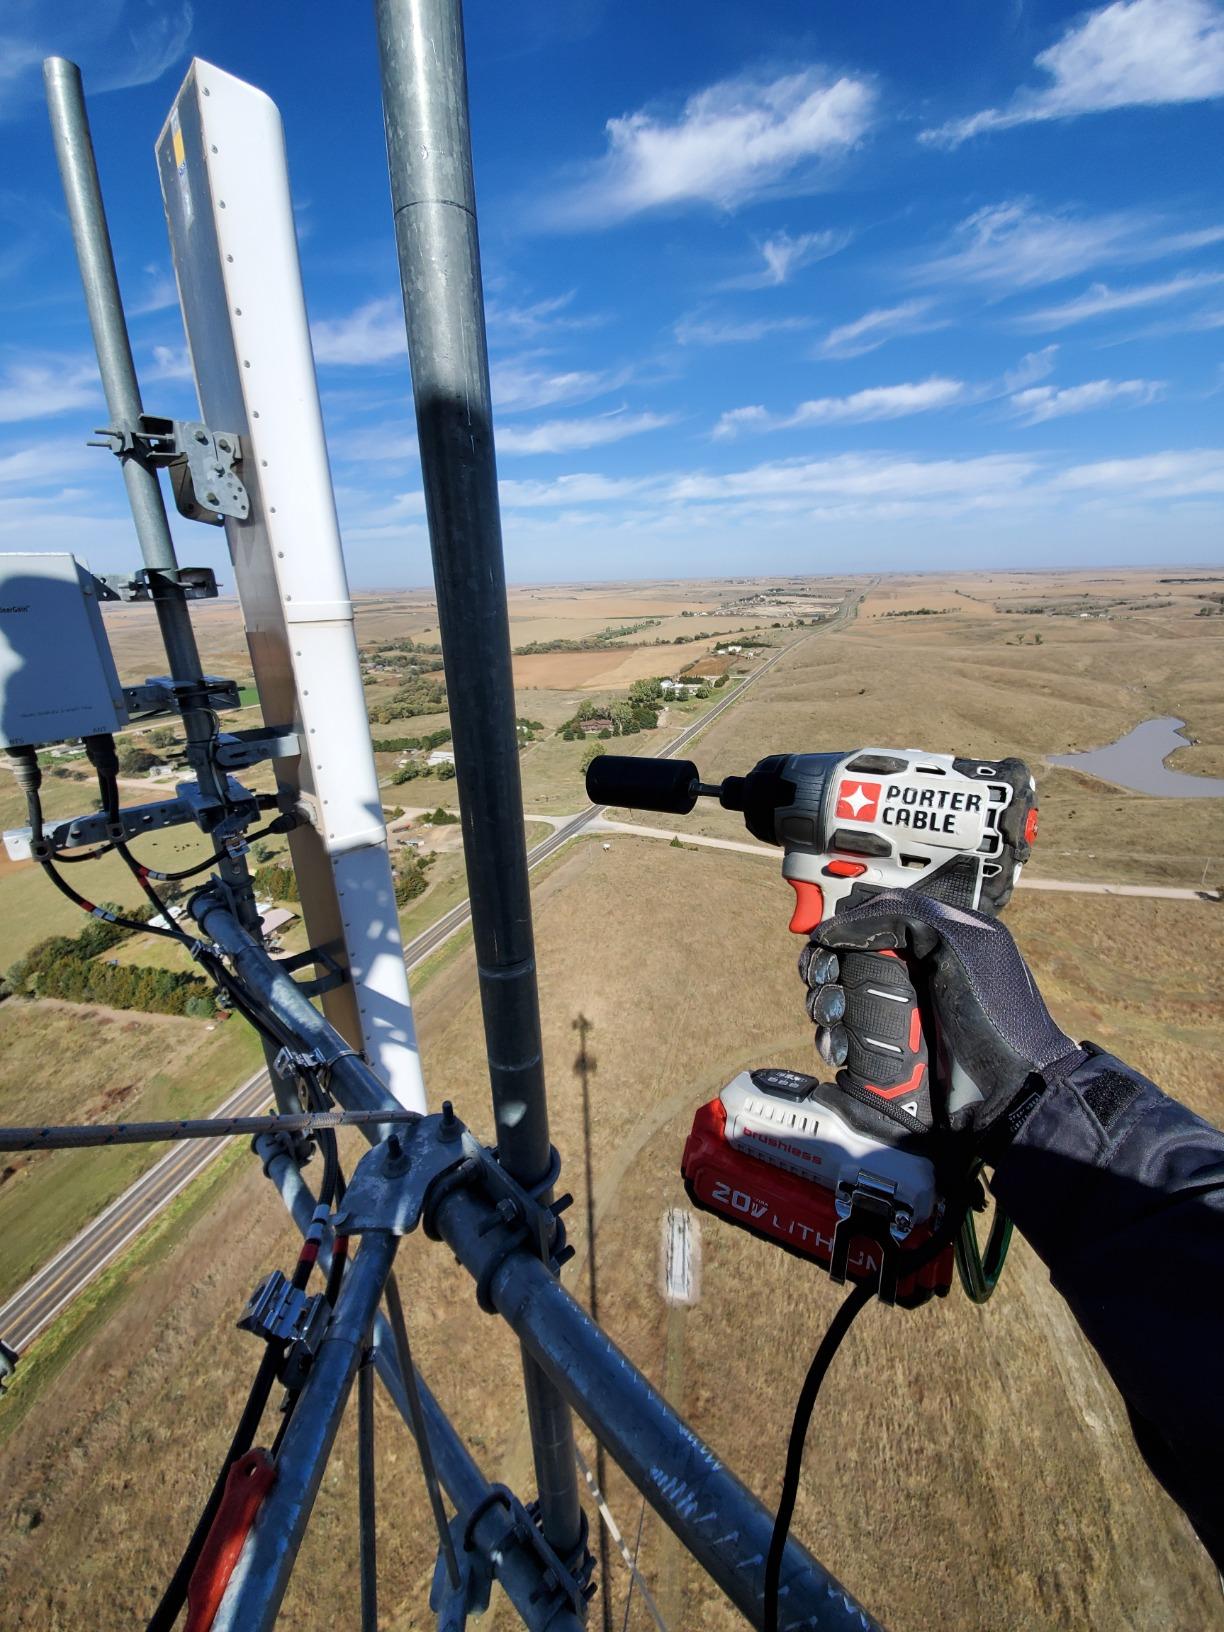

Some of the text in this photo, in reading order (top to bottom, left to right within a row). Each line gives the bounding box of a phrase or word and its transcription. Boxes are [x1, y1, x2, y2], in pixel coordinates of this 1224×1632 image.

[886, 785, 982, 812] PORTER
[882, 807, 956, 834] CABLE
[743, 1126, 822, 1165] brushless
[711, 1180, 769, 1218] 20V
